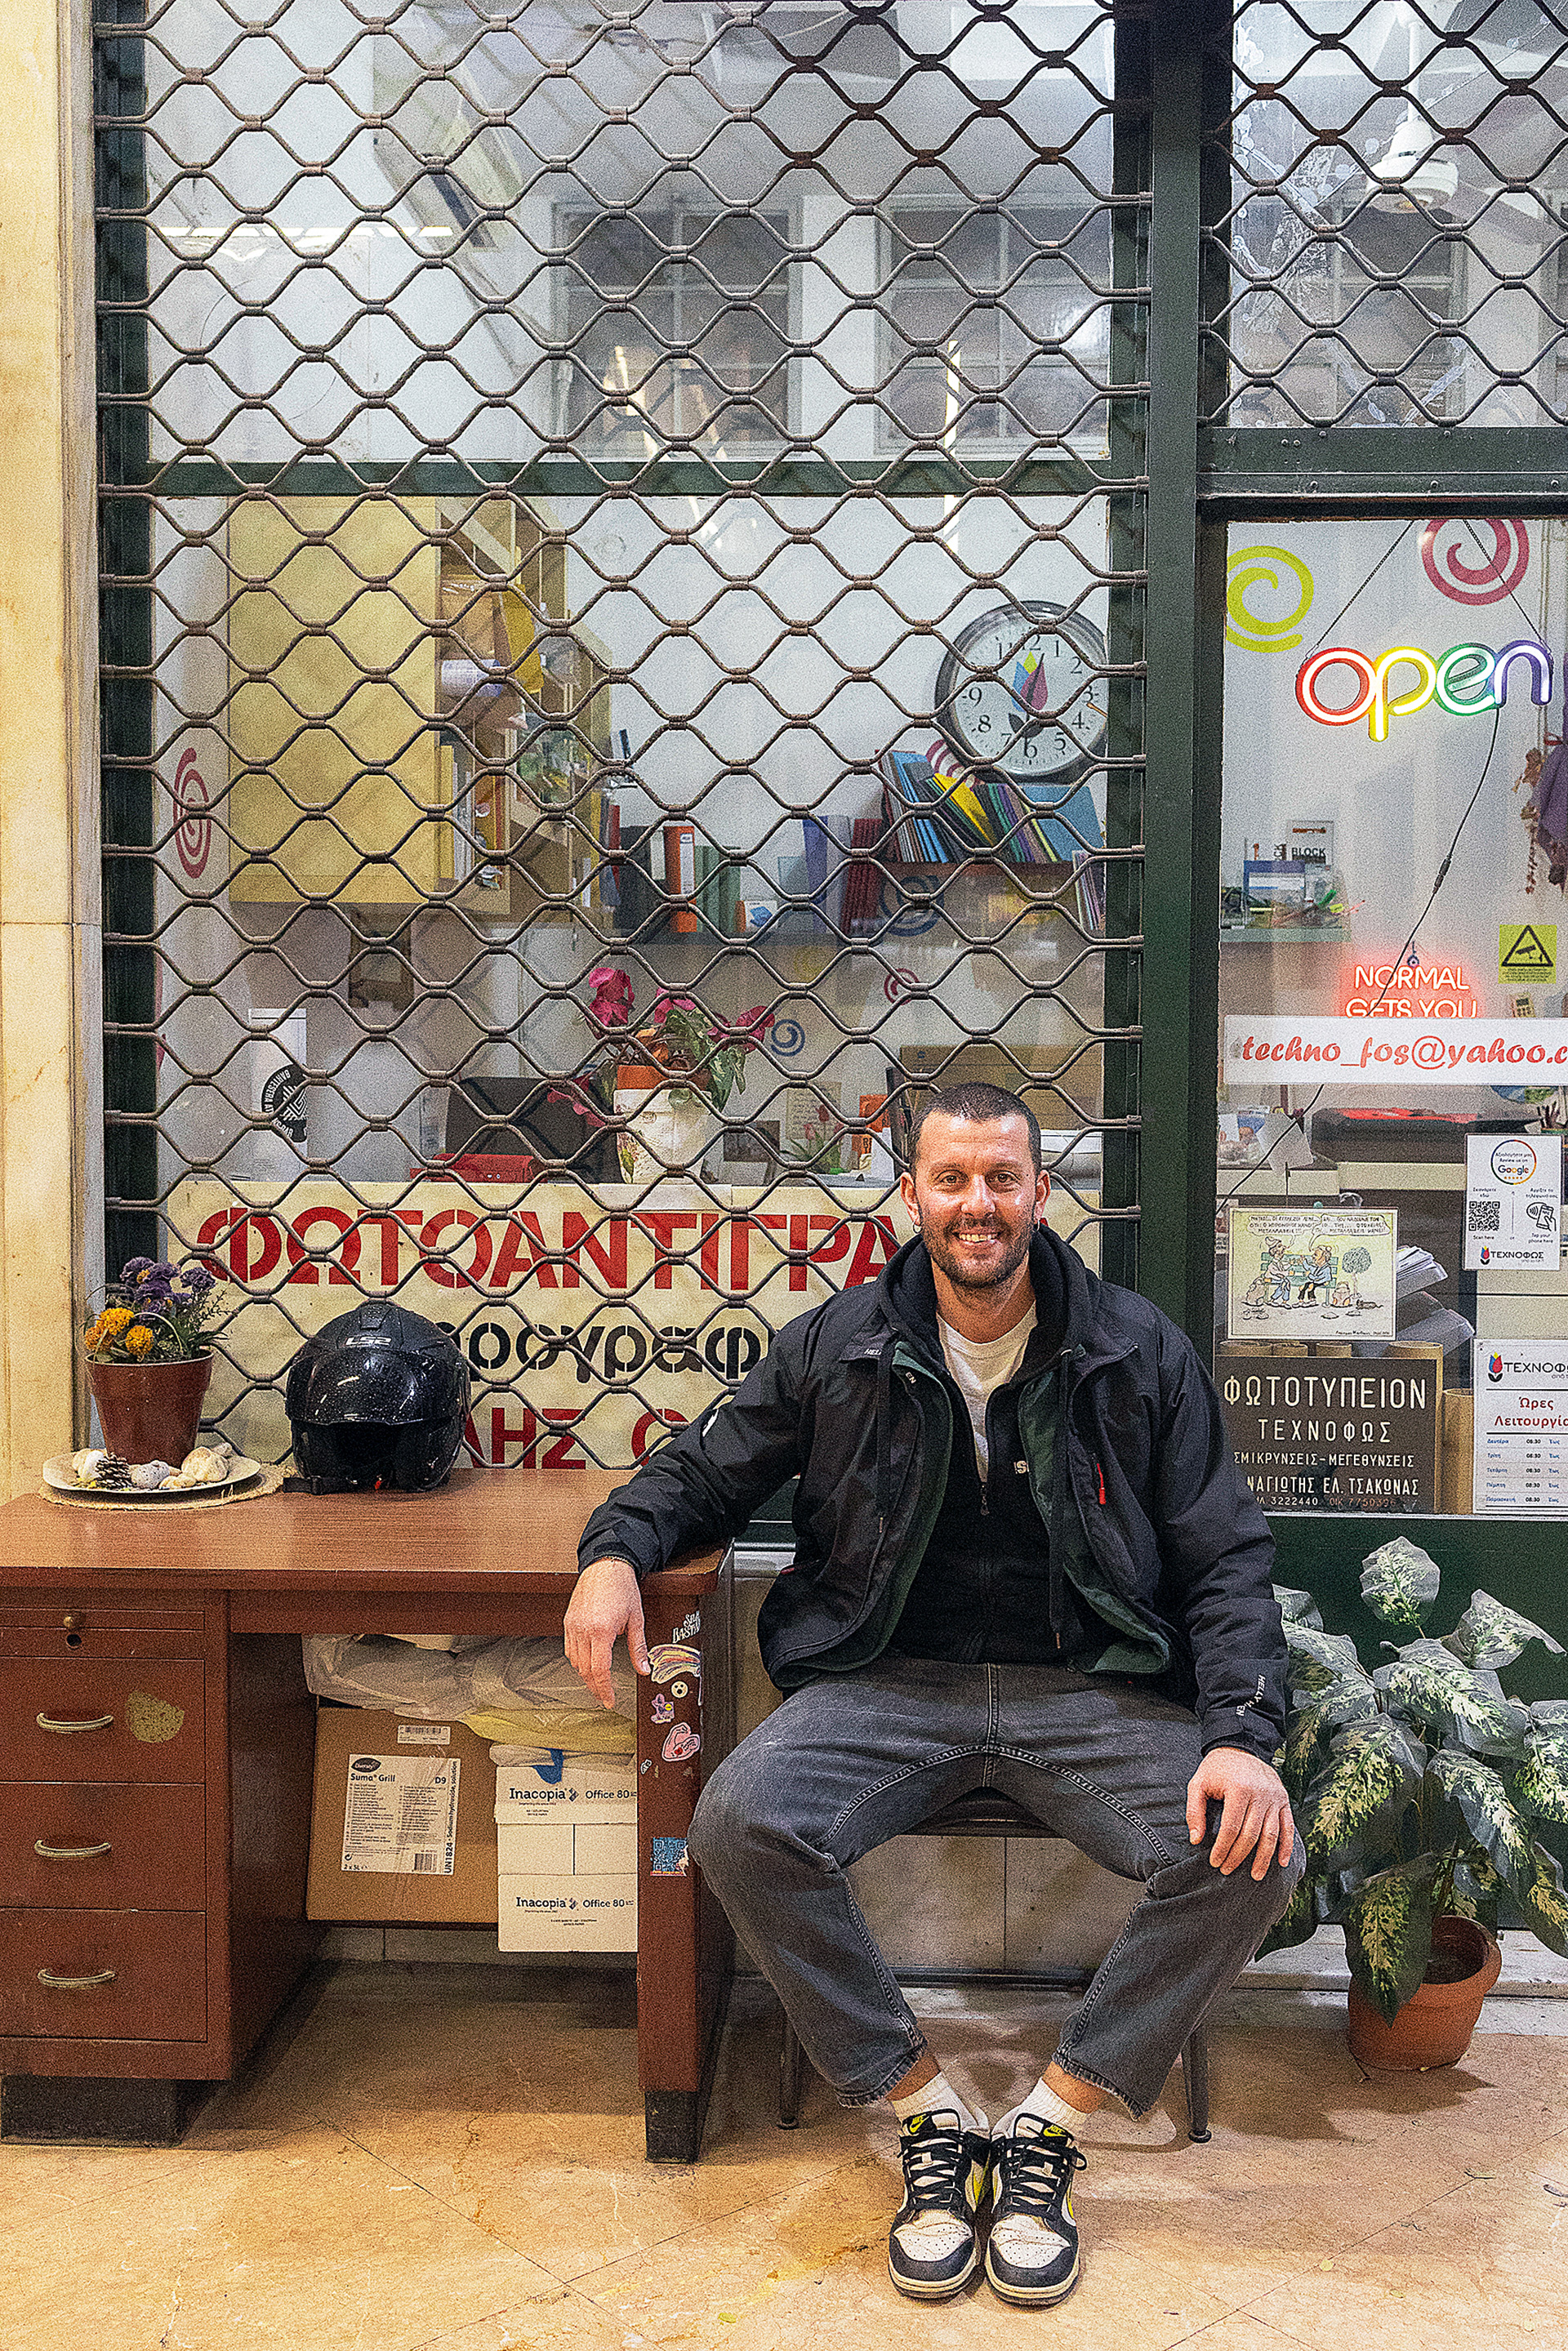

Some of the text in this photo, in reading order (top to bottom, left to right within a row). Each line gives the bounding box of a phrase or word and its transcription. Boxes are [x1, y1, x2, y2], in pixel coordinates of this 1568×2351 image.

[1295, 640, 1552, 741] open
[1292, 847, 1326, 857] BLOCK
[1354, 964, 1471, 991] NORMAL
[1419, 999, 1478, 1018] YOU
[1498, 1164, 1529, 1176] Google
[196, 1206, 1049, 1293] ΦΩΤΟΑΝΤΙΓΡΑ
[1490, 1251, 1544, 1259] ΤΕΧΝΟΦΩΣ
[344, 1335, 392, 1346] LS2
[1503, 1361, 1568, 1374] ΤΕΧΝΟΦ
[1223, 1374, 1427, 1409] ΦΩΤΟΤΥΠΕΙΟΝ
[1518, 1396, 1554, 1411] Ώρες
[1258, 1418, 1392, 1443] ΤΕΧΝΟΦΩΣ
[1247, 1476, 1316, 1494] ΝΑΓΙΩΤΗΣ
[1349, 1478, 1419, 1496] ΤΣΑΚΩΝΑΣ
[1270, 1496, 1318, 1506] 3222440
[1254, 1674, 1267, 1703] HELLY
[378, 1774, 395, 1783] Grill
[434, 1776, 447, 1785] D9
[509, 1788, 565, 1802] Inacopia
[585, 1789, 615, 1799] Office
[617, 1790, 630, 1799] 80
[443, 1842, 453, 1874] UN1824
[515, 1896, 567, 1910] Inacopia
[582, 1899, 611, 1908] Office
[612, 1899, 626, 1908] 80
